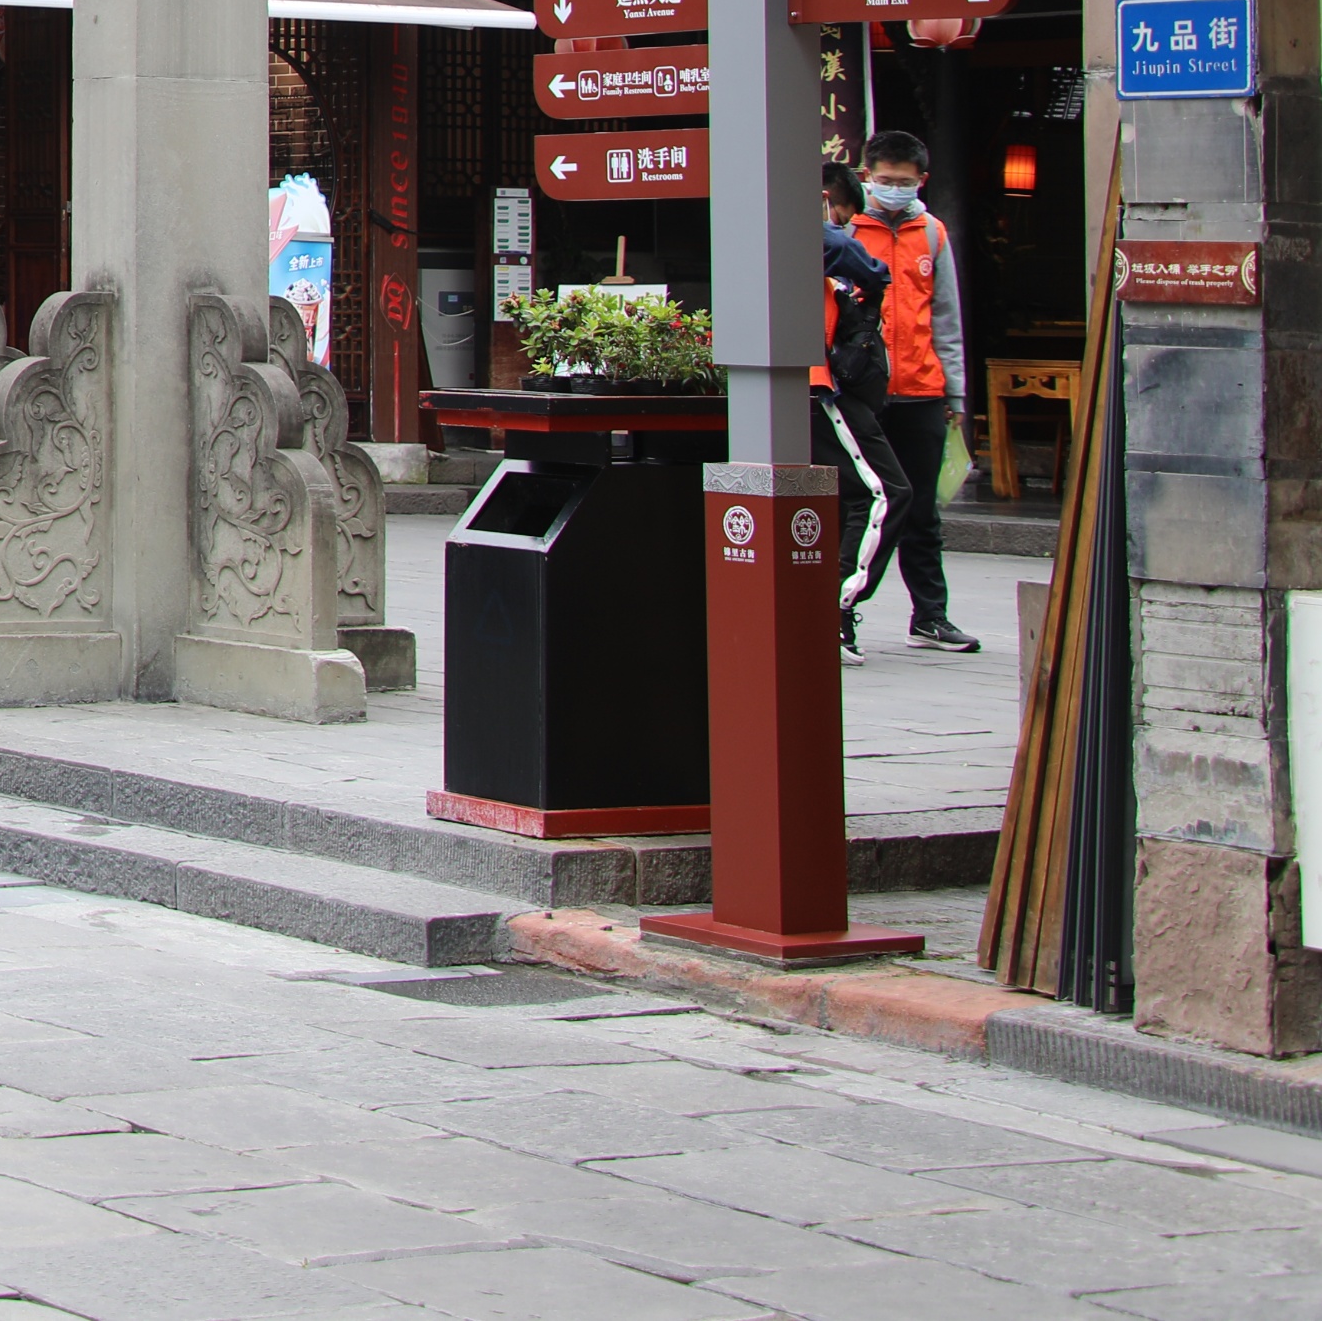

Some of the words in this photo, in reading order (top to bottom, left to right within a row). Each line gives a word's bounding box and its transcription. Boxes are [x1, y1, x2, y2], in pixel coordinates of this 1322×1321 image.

[623, 8, 646, 19] Yanxi
[647, 7, 675, 18] Avenue
[1131, 17, 1238, 52] 九品街
[1132, 60, 1181, 77] Jiupin
[1188, 58, 1238, 72] Street
[602, 70, 652, 87] 家庭卫生间
[679, 67, 709, 83] 哺乳室
[602, 88, 623, 97] Family
[624, 86, 653, 95] Restroom
[679, 83, 696, 93] Baby
[637, 145, 687, 169] 洗手间
[641, 172, 684, 182] Restrooms
[288, 254, 324, 272] 全新上市
[1131, 263, 1181, 275] 垃圾入桶
[1186, 264, 1239, 276] 举手之劳
